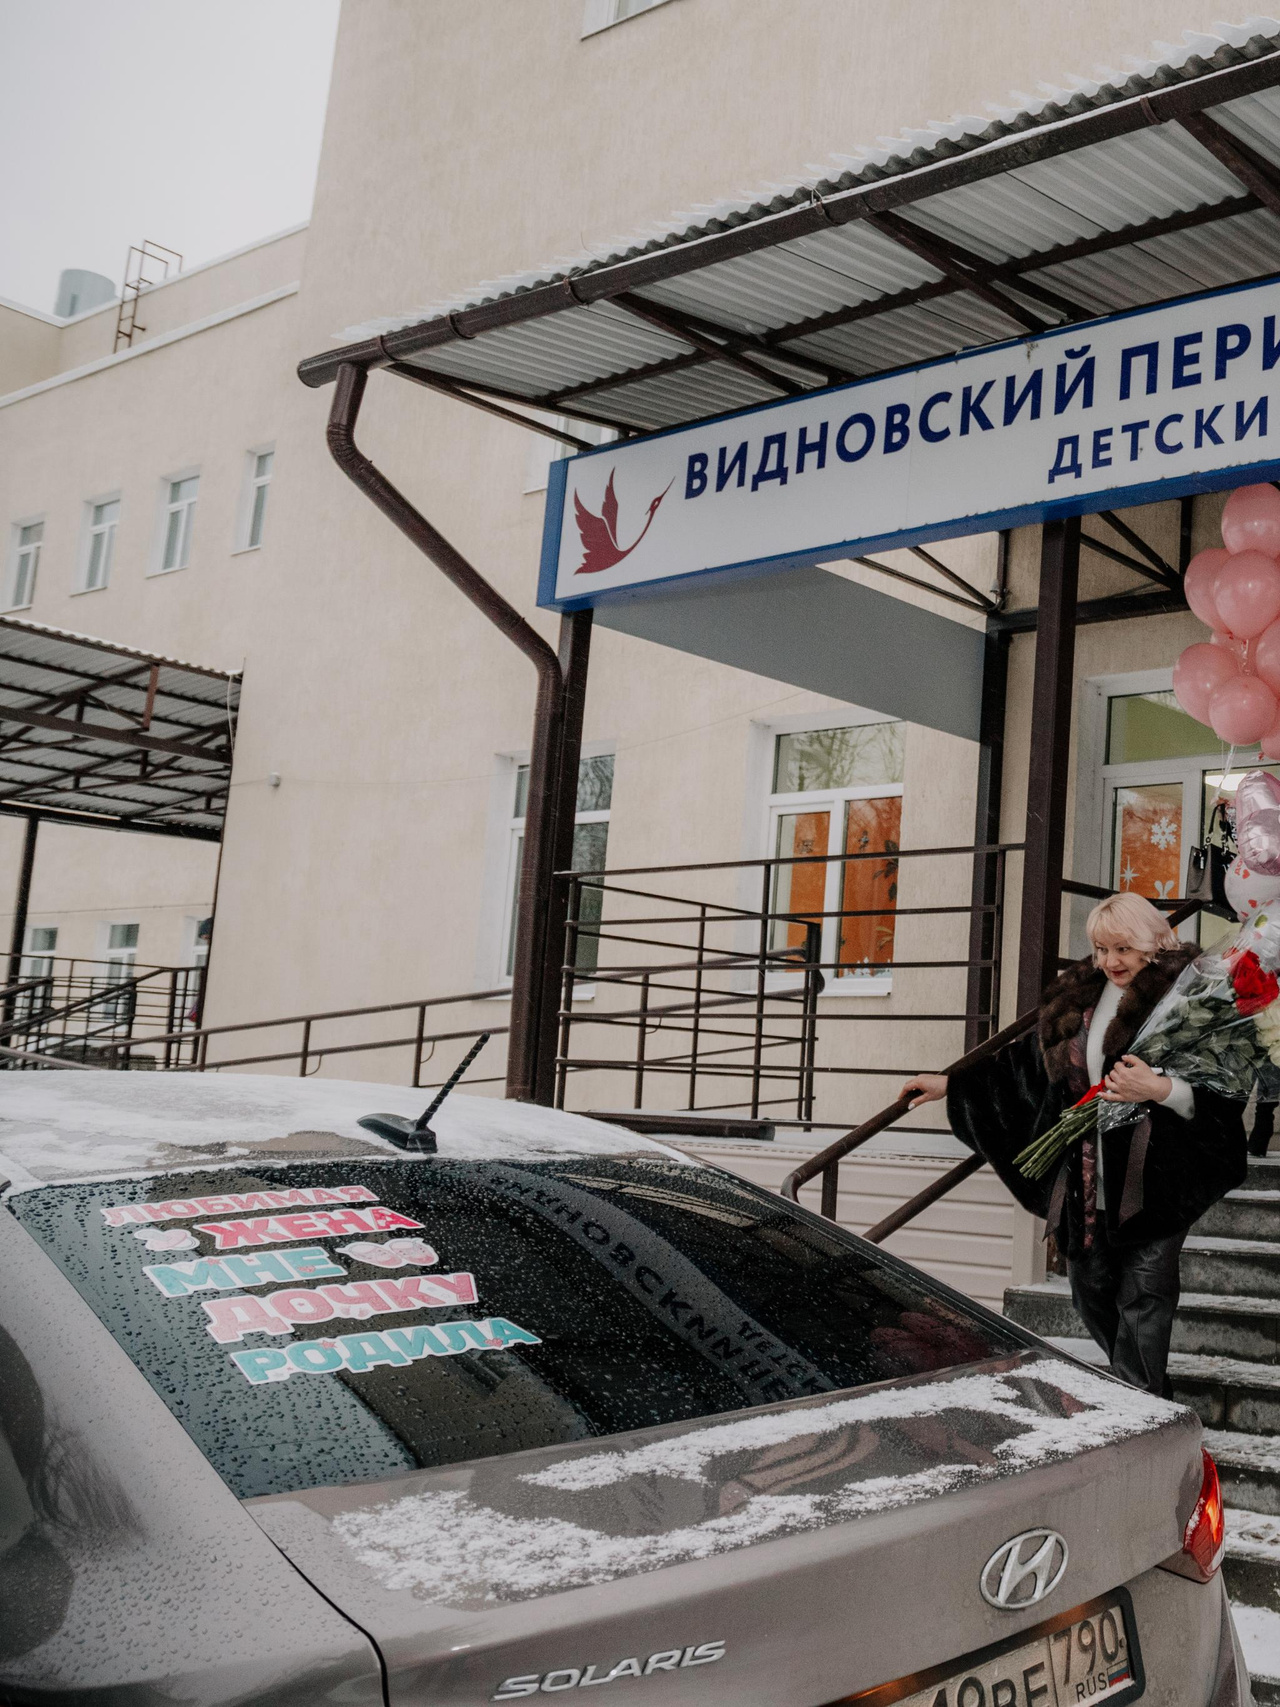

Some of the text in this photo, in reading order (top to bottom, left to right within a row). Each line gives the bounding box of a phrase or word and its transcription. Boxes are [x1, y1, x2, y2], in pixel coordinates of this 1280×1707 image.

[684, 344, 1096, 499] ВИДНОВСКИЙ
[105, 1186, 378, 1224] ЛЮБИМАЯ
[202, 1208, 421, 1247] ЖЕНА
[149, 1248, 343, 1294] МНЕ
[207, 1274, 474, 1340] ДОЧКУ
[234, 1319, 540, 1381] РОДИЛА
[490, 1640, 726, 1702] SOLARIS
[1053, 1610, 1119, 1686] 790
[1076, 1672, 1108, 1702] RUS
